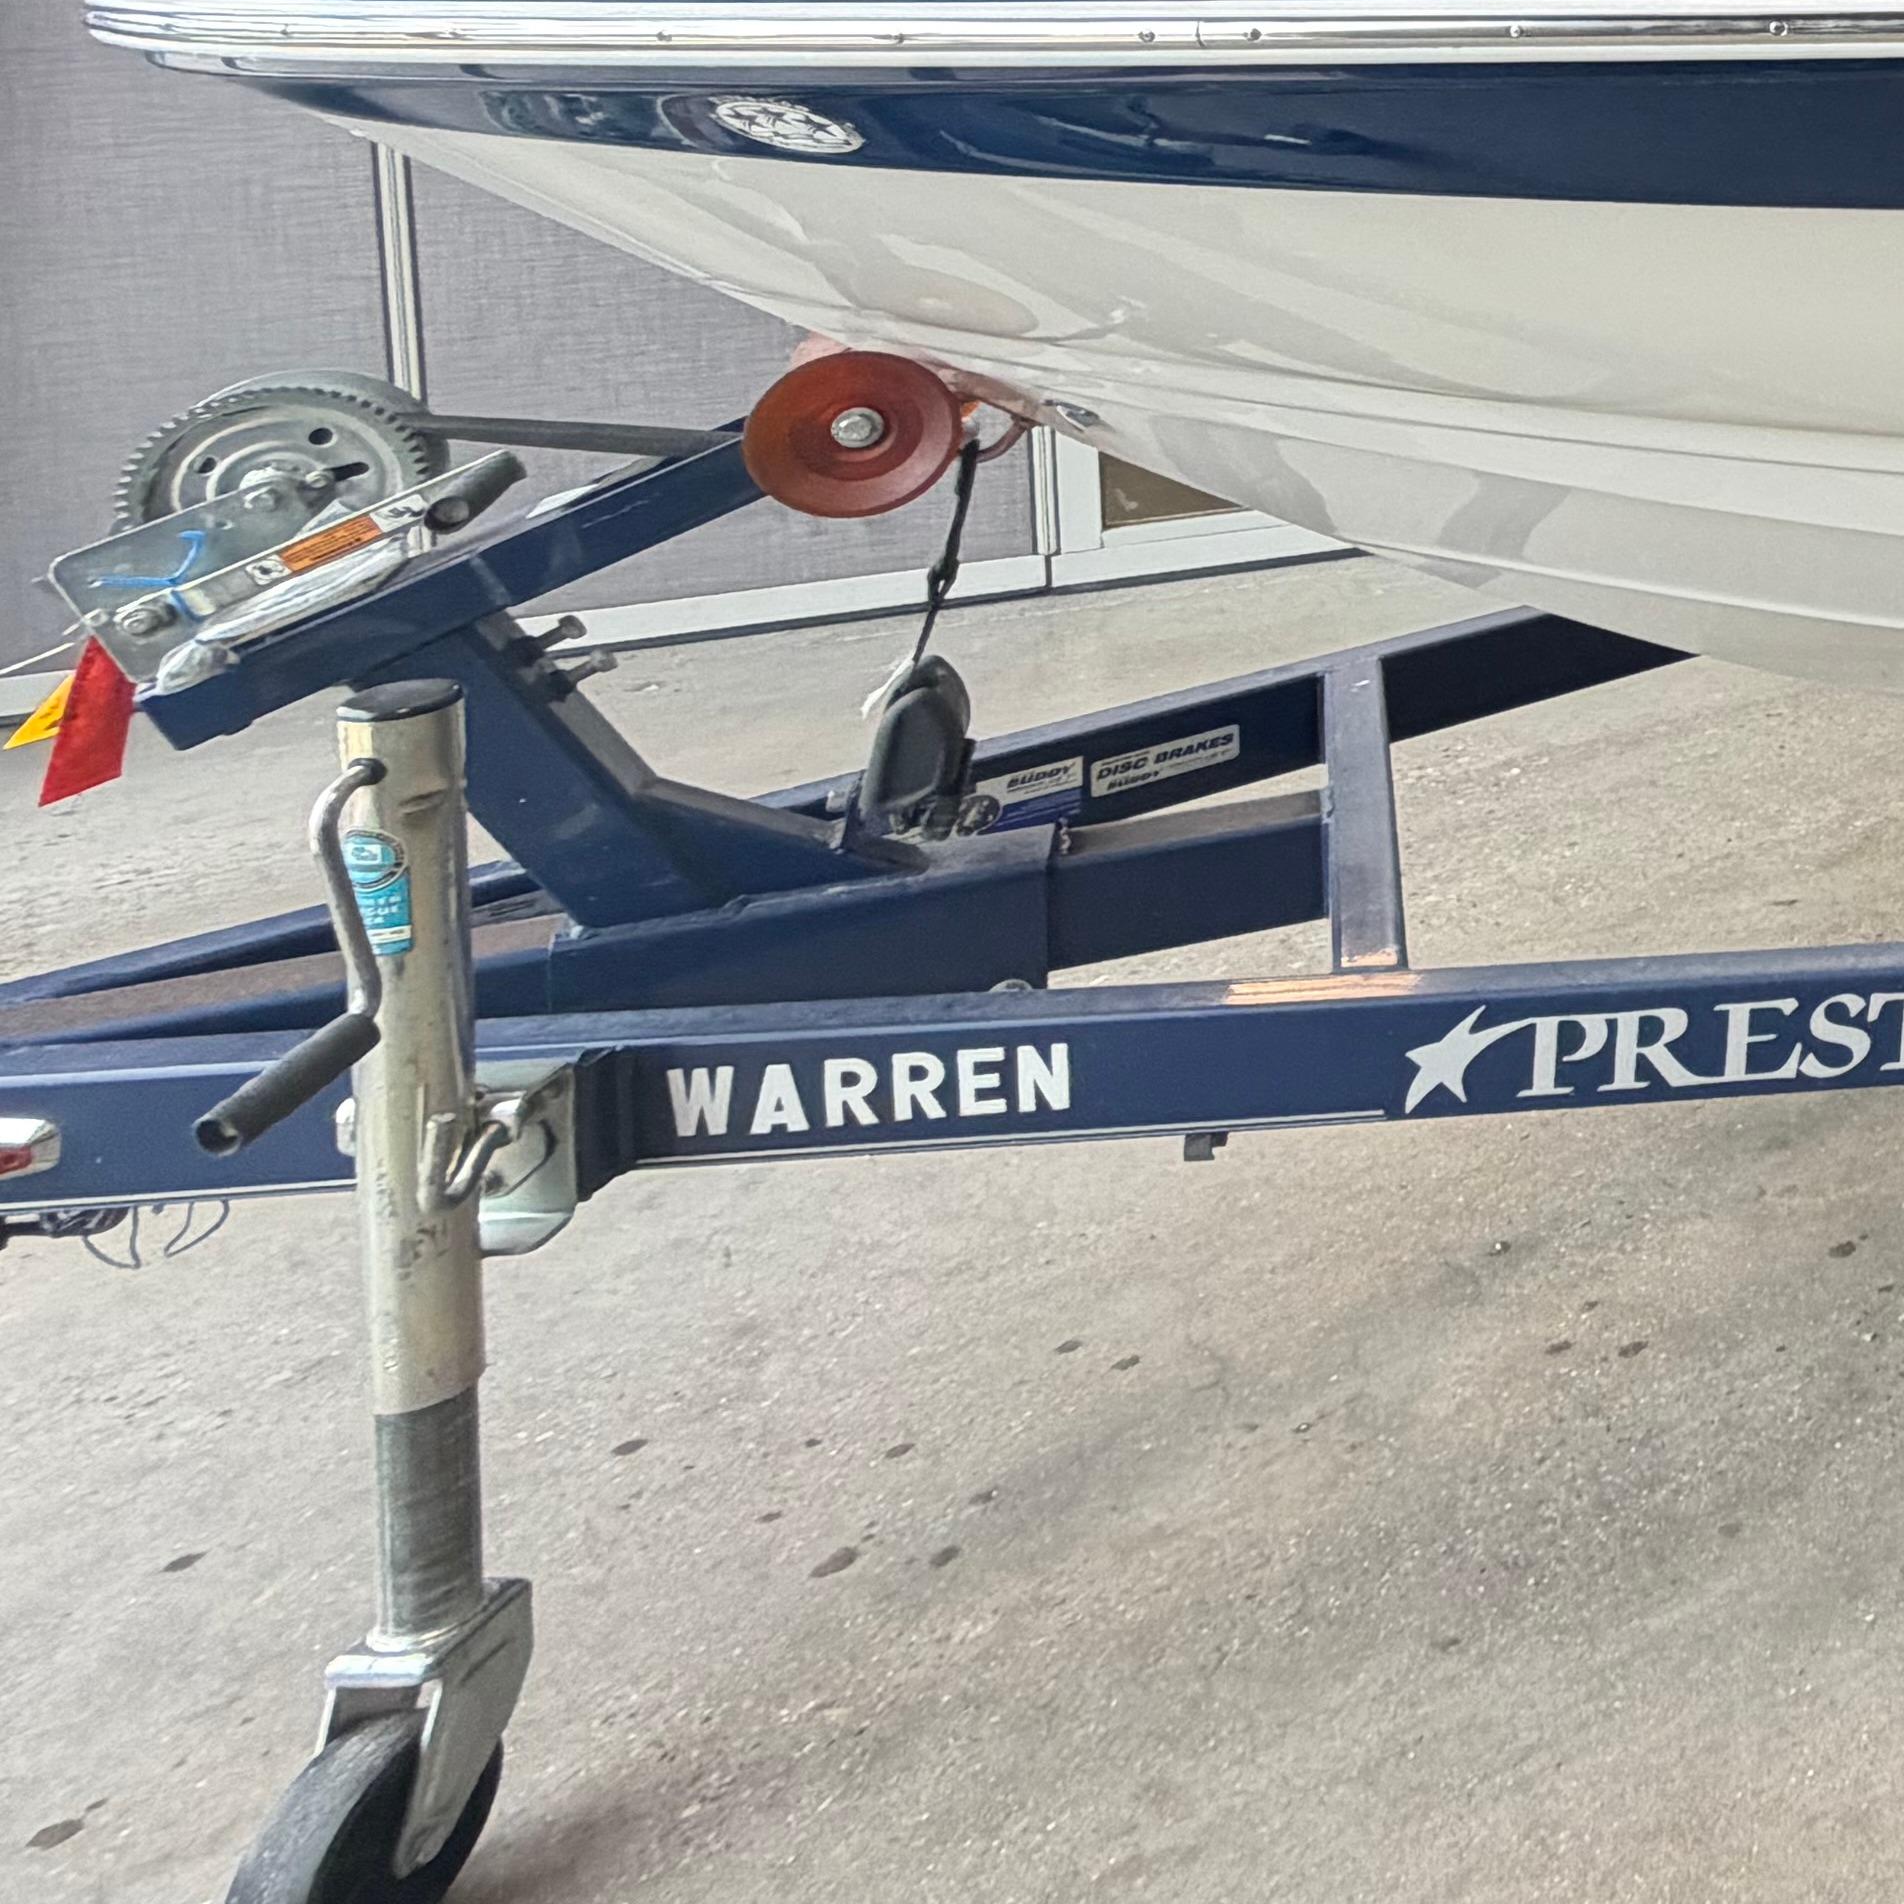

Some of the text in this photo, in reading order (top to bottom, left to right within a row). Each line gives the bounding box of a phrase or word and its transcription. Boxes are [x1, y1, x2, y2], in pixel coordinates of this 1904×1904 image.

[1096, 756, 1149, 780] DISC
[1154, 733, 1234, 764] BRAKES
[666, 1042, 1071, 1137] WARREN
